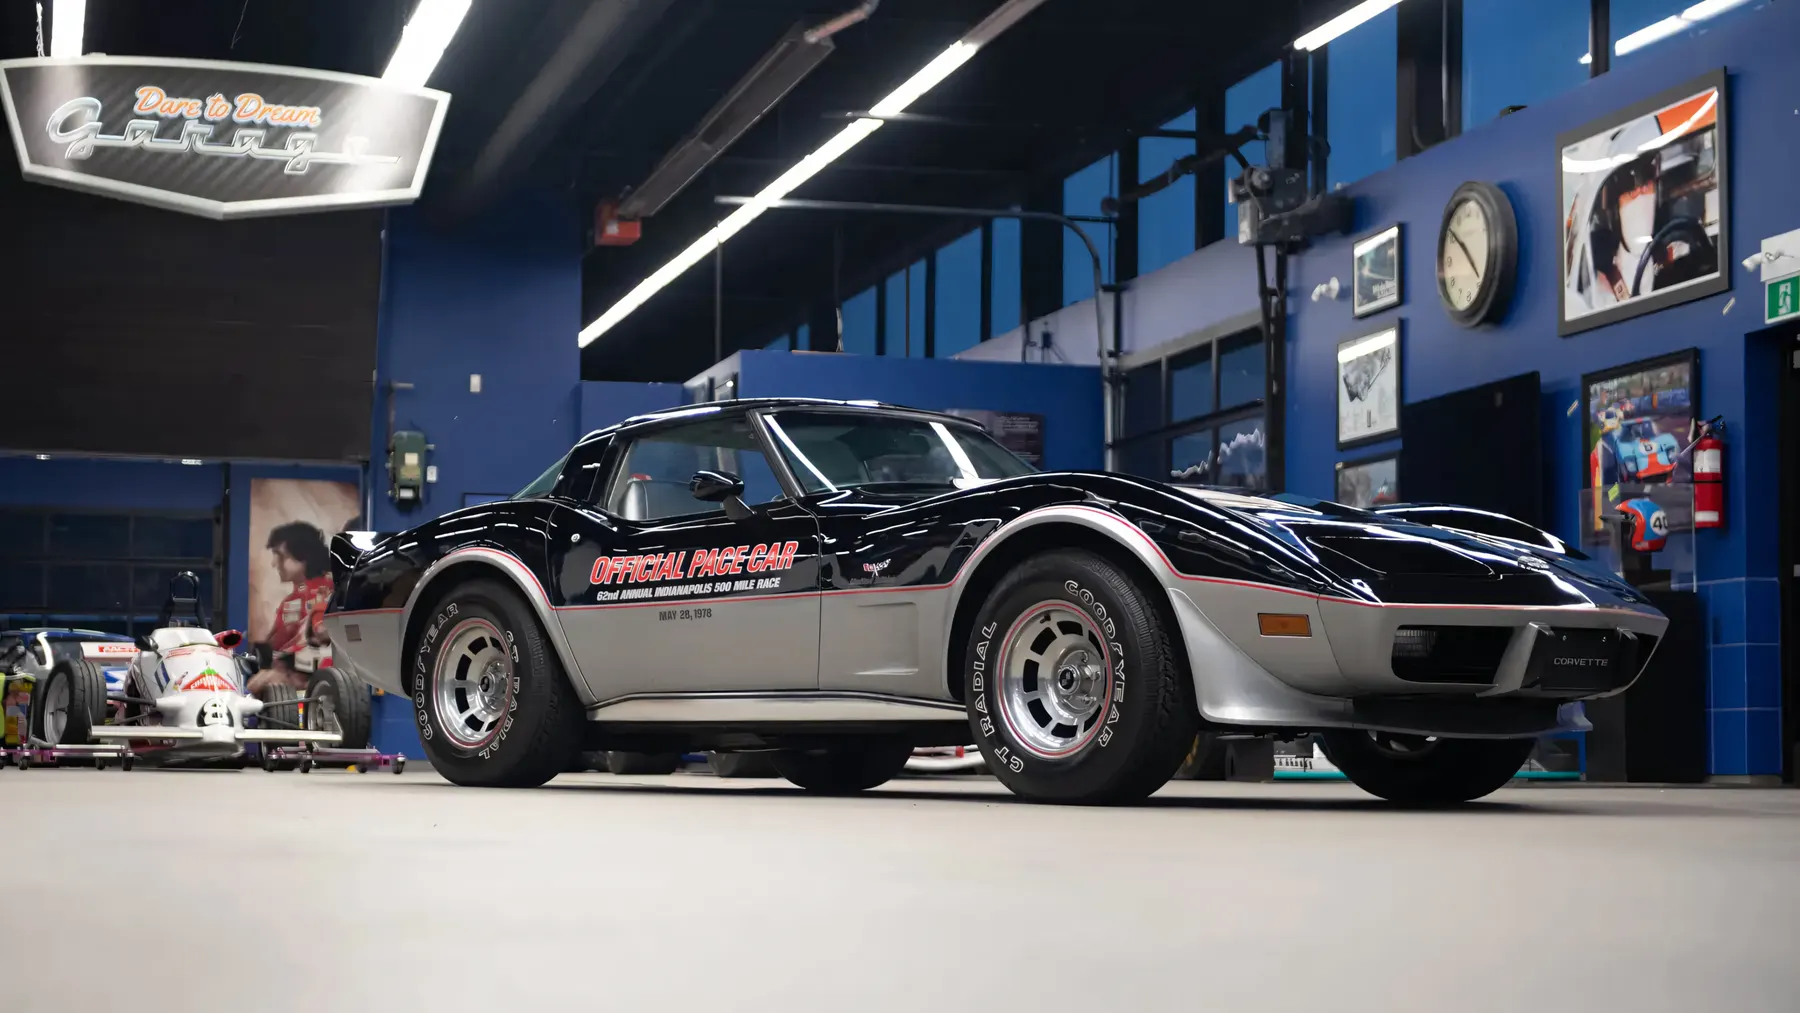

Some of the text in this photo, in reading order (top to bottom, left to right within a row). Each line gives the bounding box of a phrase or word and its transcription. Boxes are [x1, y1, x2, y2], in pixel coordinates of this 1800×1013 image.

[46, 97, 401, 175] Garage
[134, 86, 321, 128] Dare to Dream
[590, 541, 799, 584] OFFICIAL PACE CAR
[597, 577, 781, 602] 62nd ANNUAL INDIANAPOLIS 500 MILE RACE
[659, 610, 677, 621] MAY
[415, 602, 459, 740] GOODYEAR
[1064, 580, 1126, 747] GOODYEAR
[1553, 656, 1608, 668] CORVETTE
[478, 630, 521, 760] GT RADIAL
[973, 621, 1024, 773] GT RADIAL
